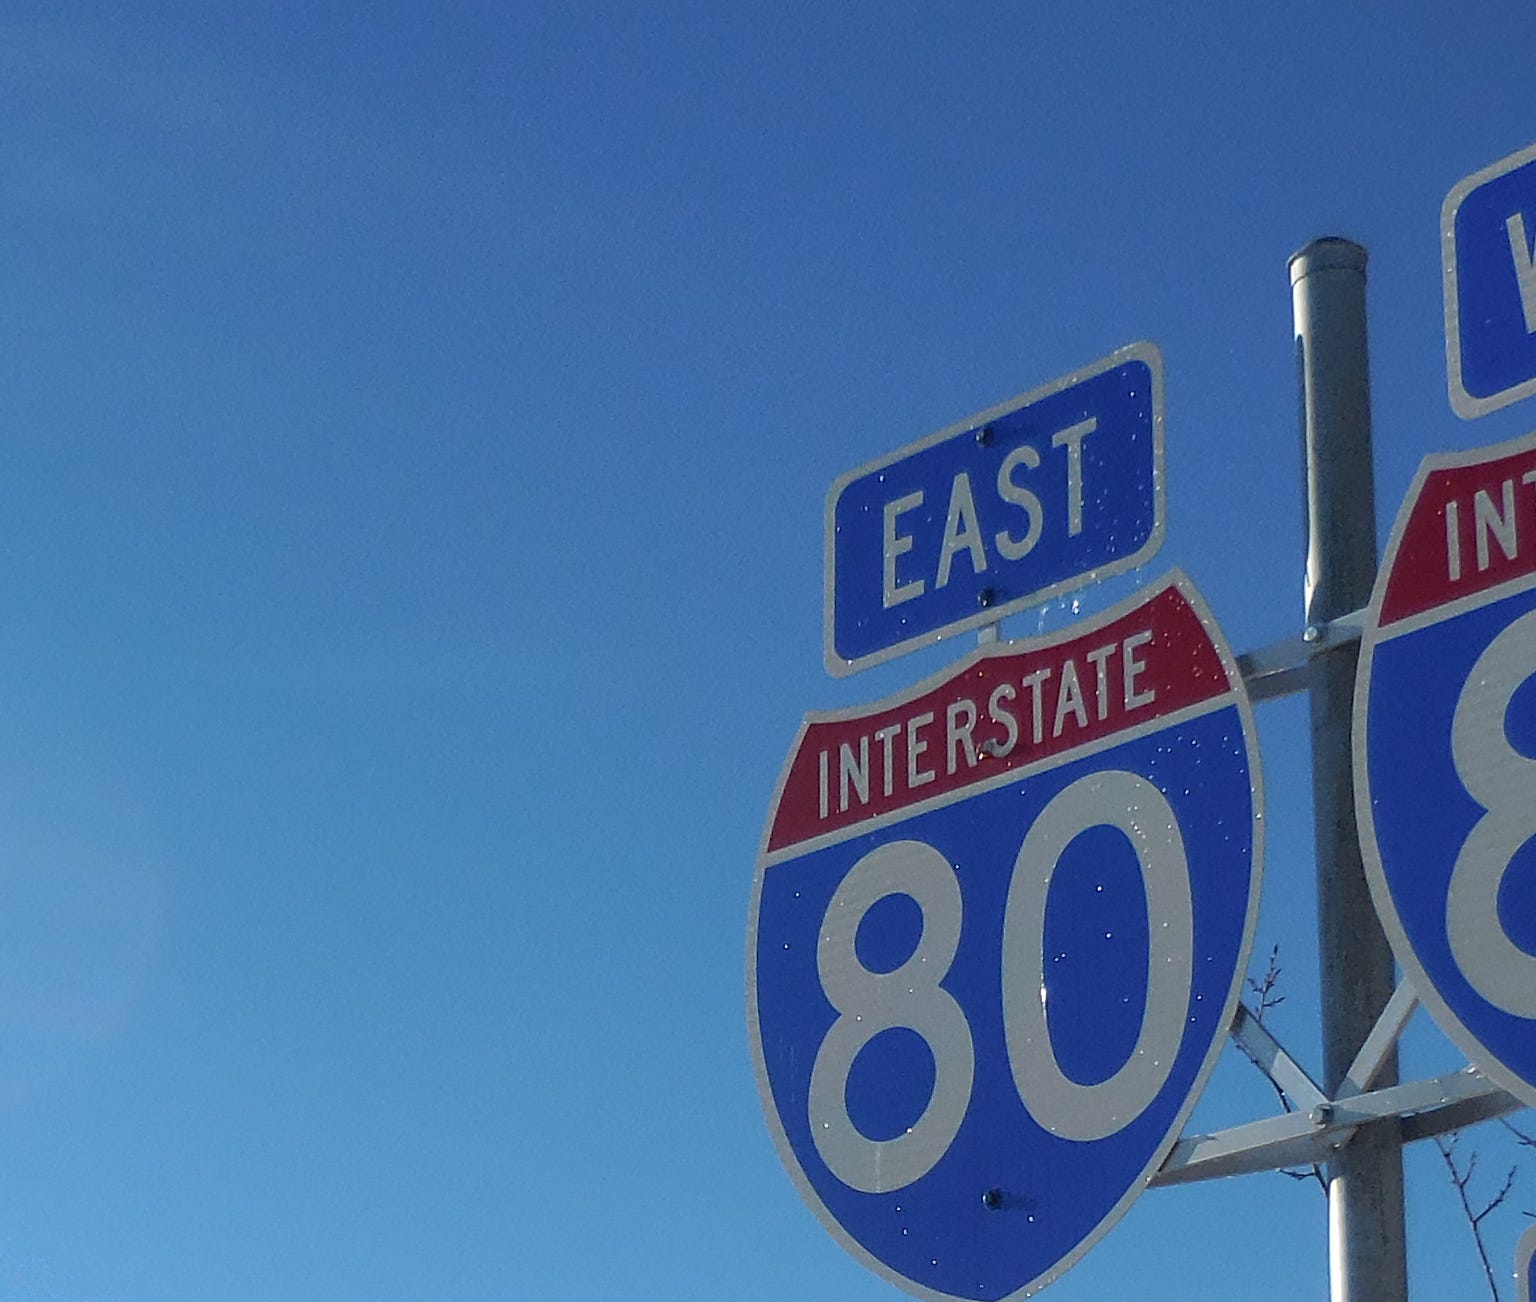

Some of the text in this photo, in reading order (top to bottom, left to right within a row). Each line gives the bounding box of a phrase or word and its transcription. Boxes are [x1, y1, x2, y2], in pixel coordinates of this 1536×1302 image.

[882, 417, 1097, 609] EAST
[818, 630, 1156, 820] INTERSTATE
[807, 769, 1193, 1194] 80
